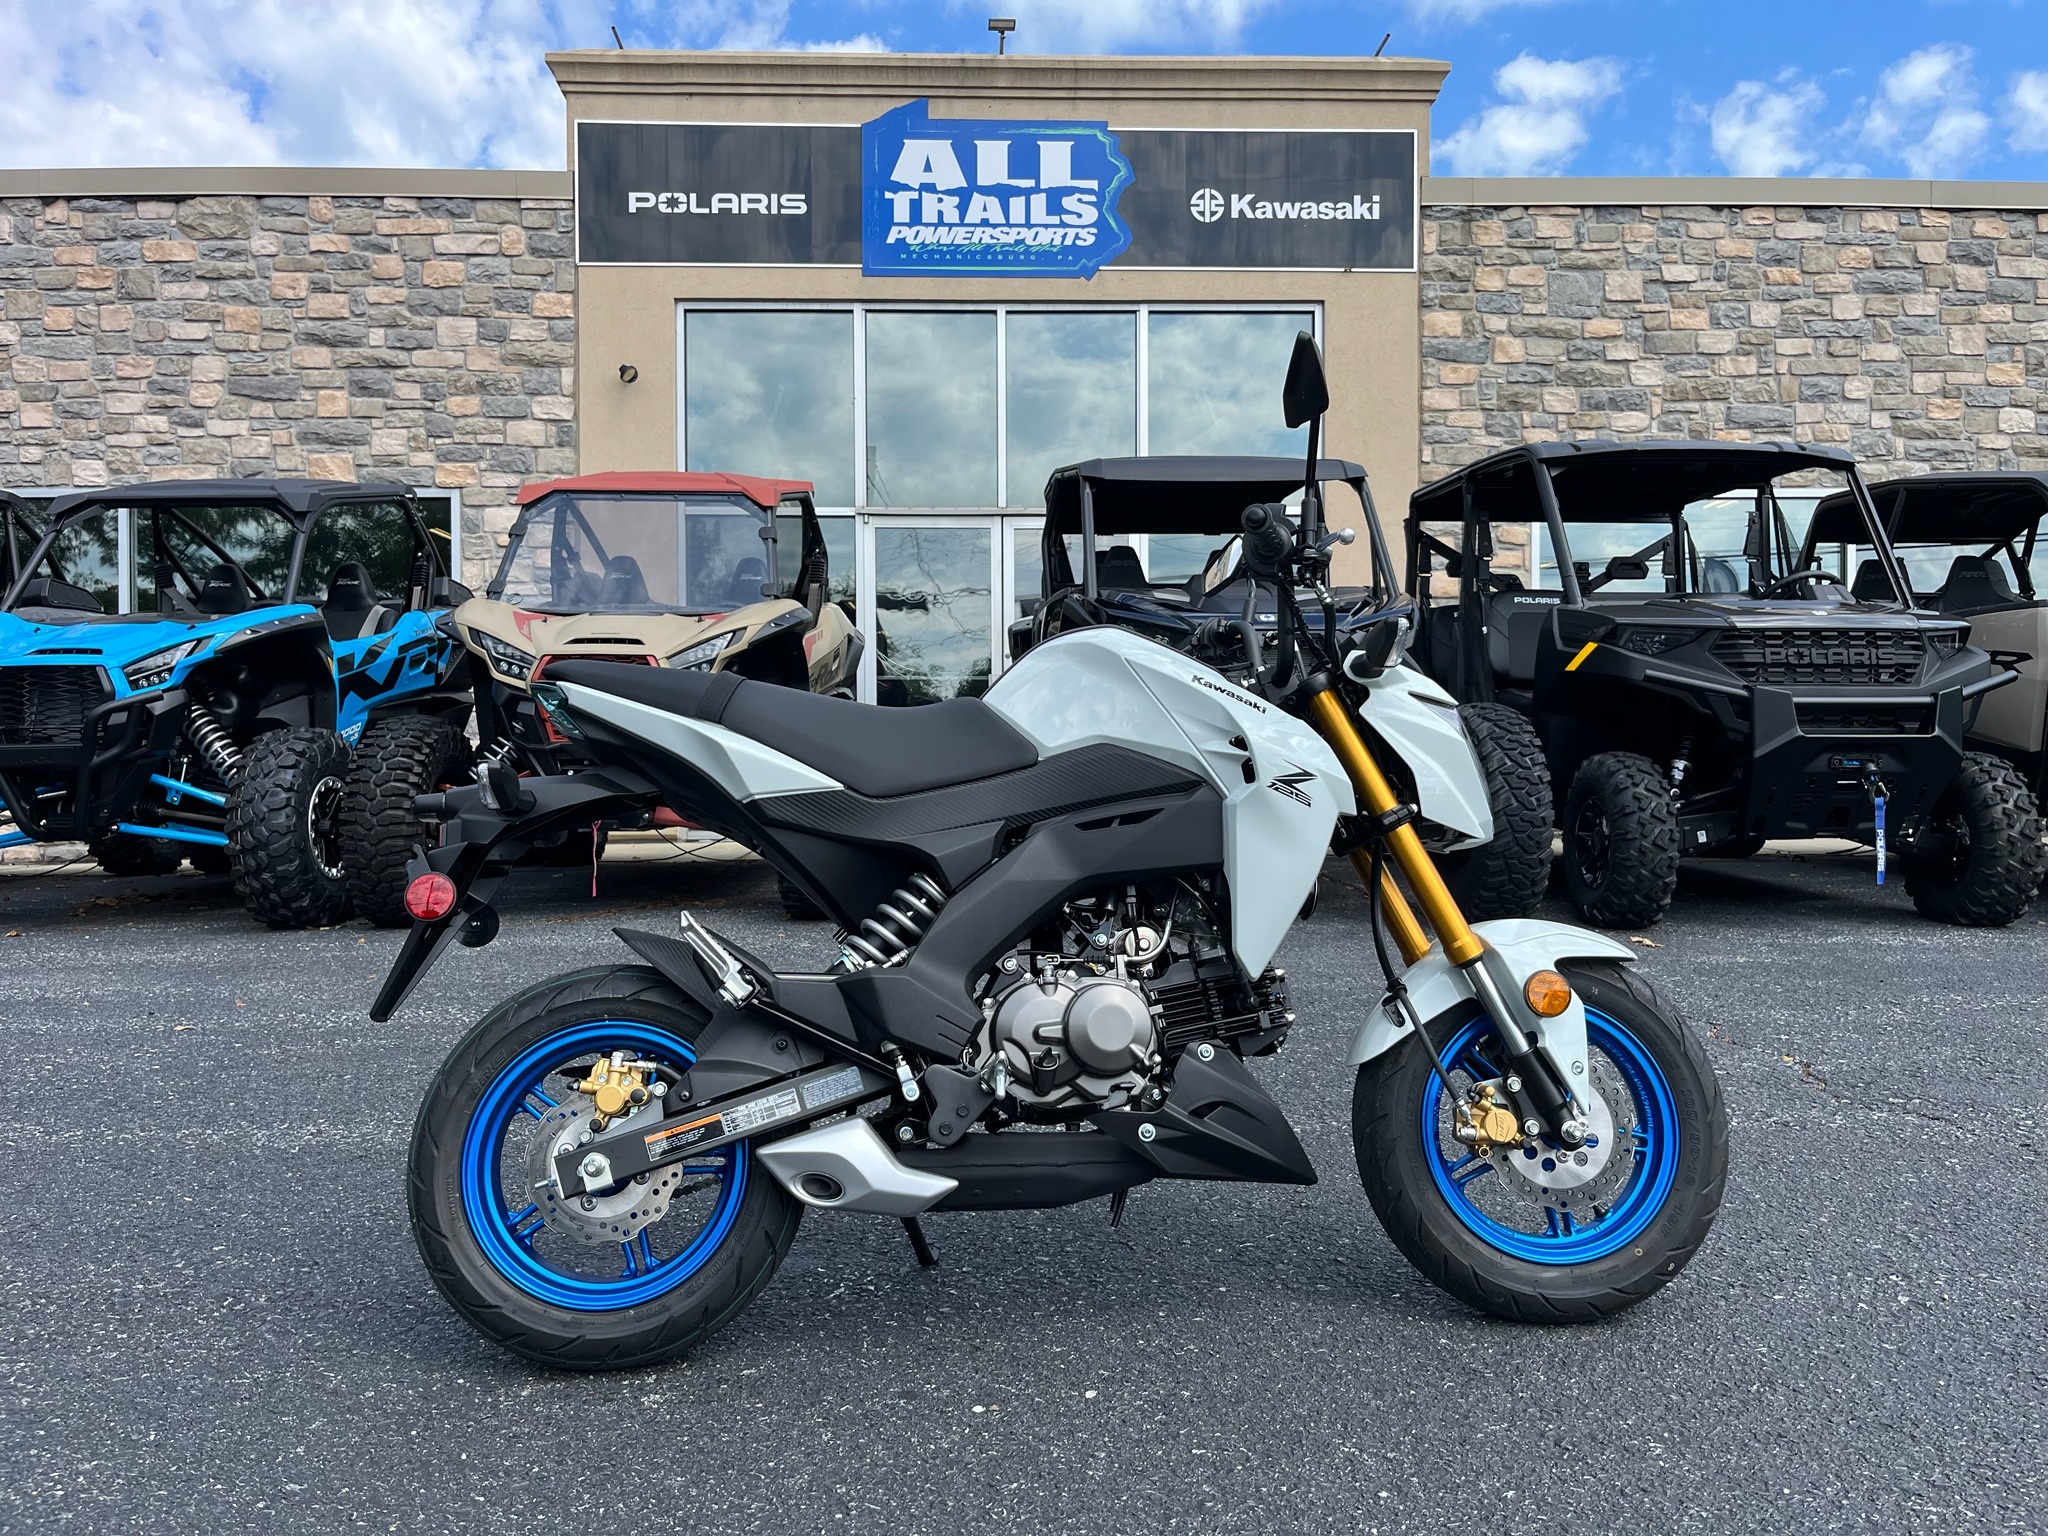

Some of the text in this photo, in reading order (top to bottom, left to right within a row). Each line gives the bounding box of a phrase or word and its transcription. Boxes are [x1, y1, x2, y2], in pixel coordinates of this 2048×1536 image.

[890, 139, 1099, 192] ALL
[628, 192, 808, 215] POLARIS
[884, 190, 1099, 225] TRAILS
[1230, 194, 1380, 219] Kawasaki
[886, 225, 1098, 246] POWERSPORTS
[1513, 596, 1560, 605] POLARIS
[1764, 647, 1898, 665] POLARIS
[1191, 674, 1267, 715] Kawasaki
[1266, 781, 1312, 808] 125
[1876, 829, 1885, 872] POLARIS
